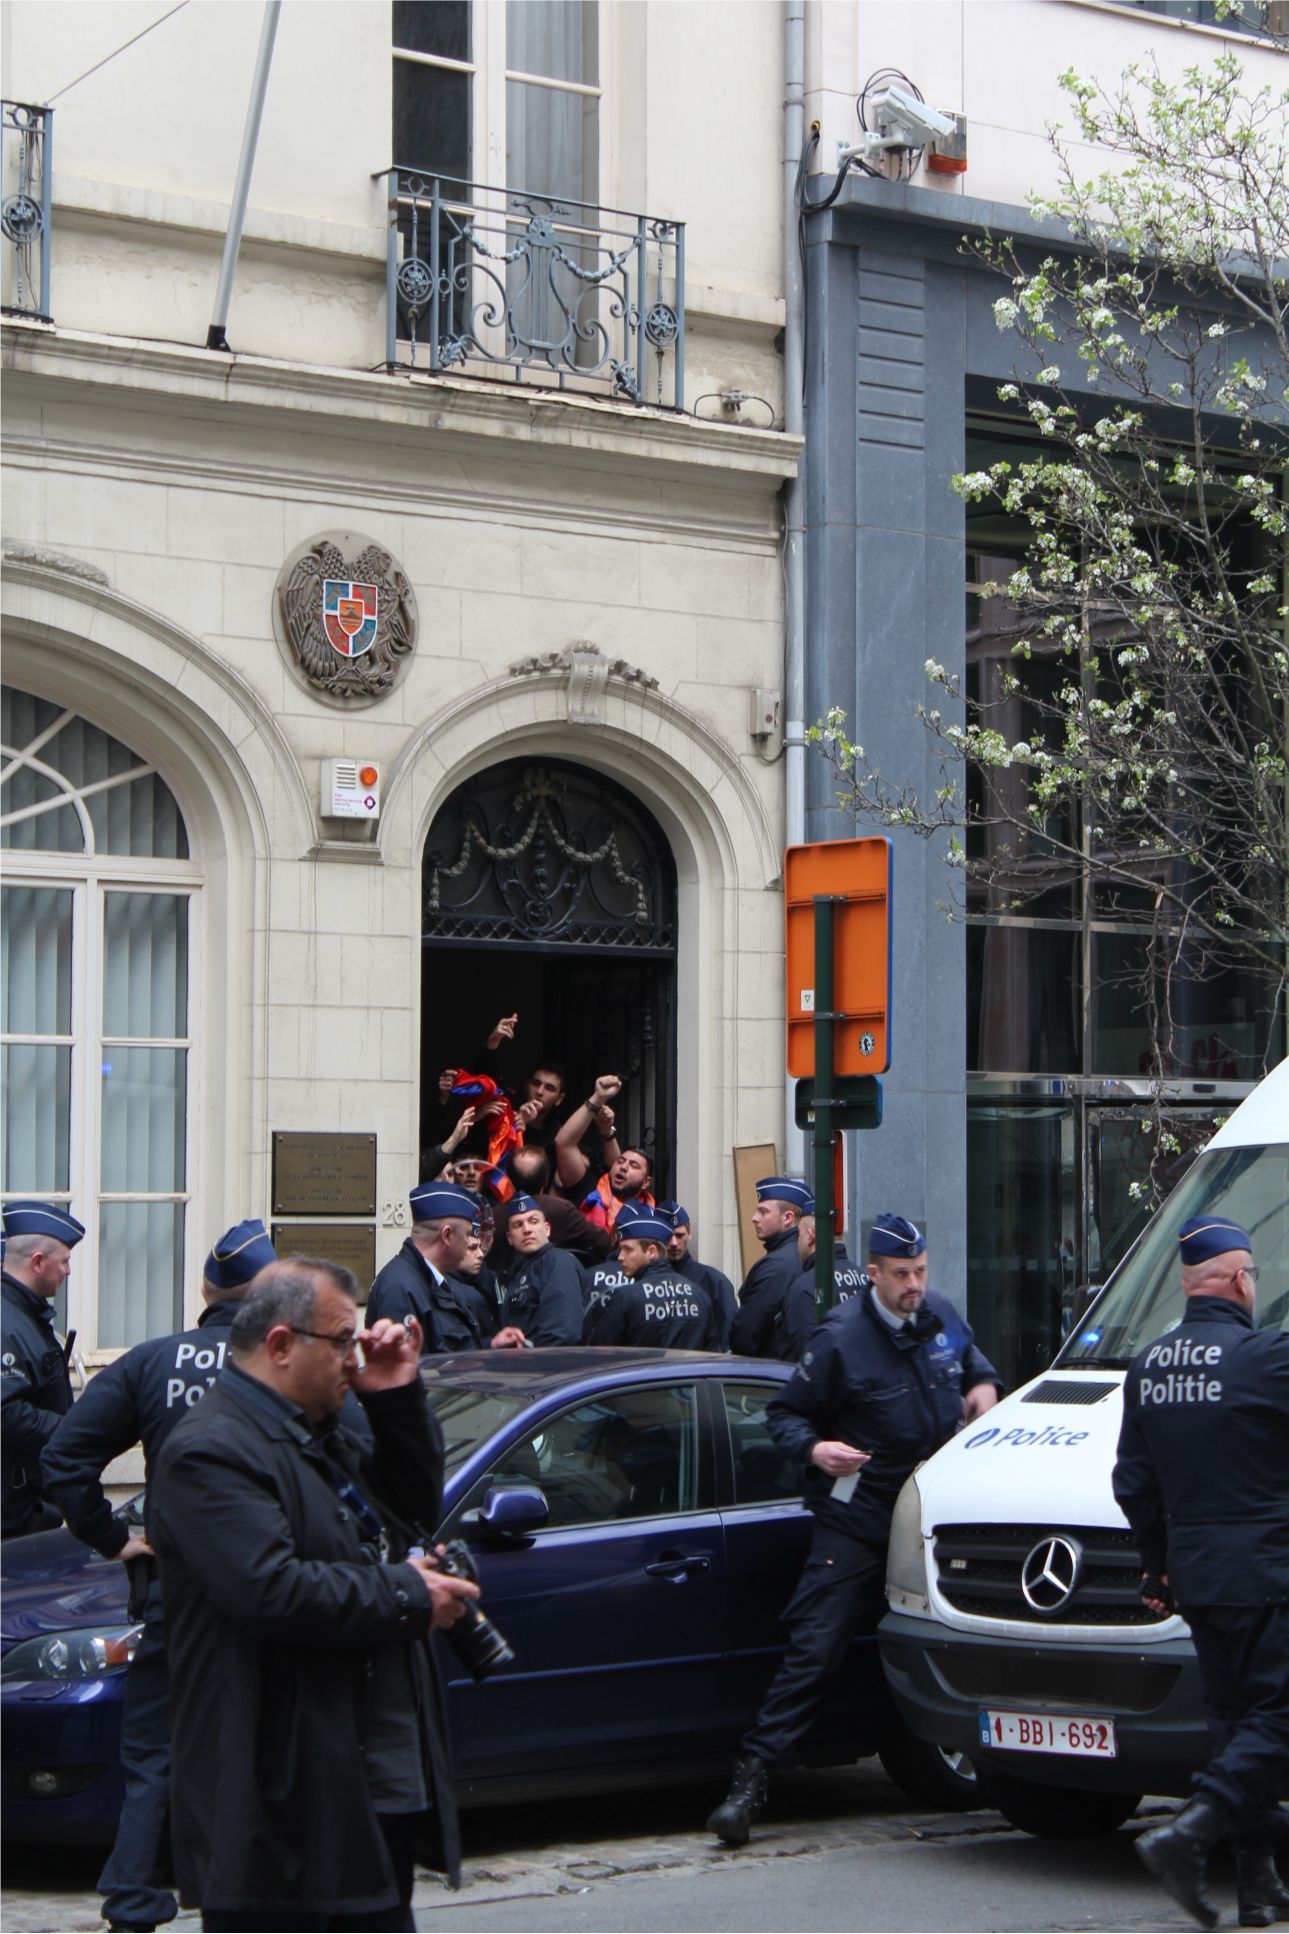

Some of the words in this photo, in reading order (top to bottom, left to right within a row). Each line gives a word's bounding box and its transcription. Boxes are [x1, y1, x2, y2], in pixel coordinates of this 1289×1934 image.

[382, 1201, 406, 1227] 28
[834, 1269, 870, 1287] Polic
[643, 1280, 692, 1299] Police
[645, 1299, 699, 1321] Politie
[1144, 1339, 1222, 1369] Police
[1140, 1373, 1222, 1406] Politie
[993, 1425, 1090, 1447] Police
[982, 1730, 989, 1743] B
